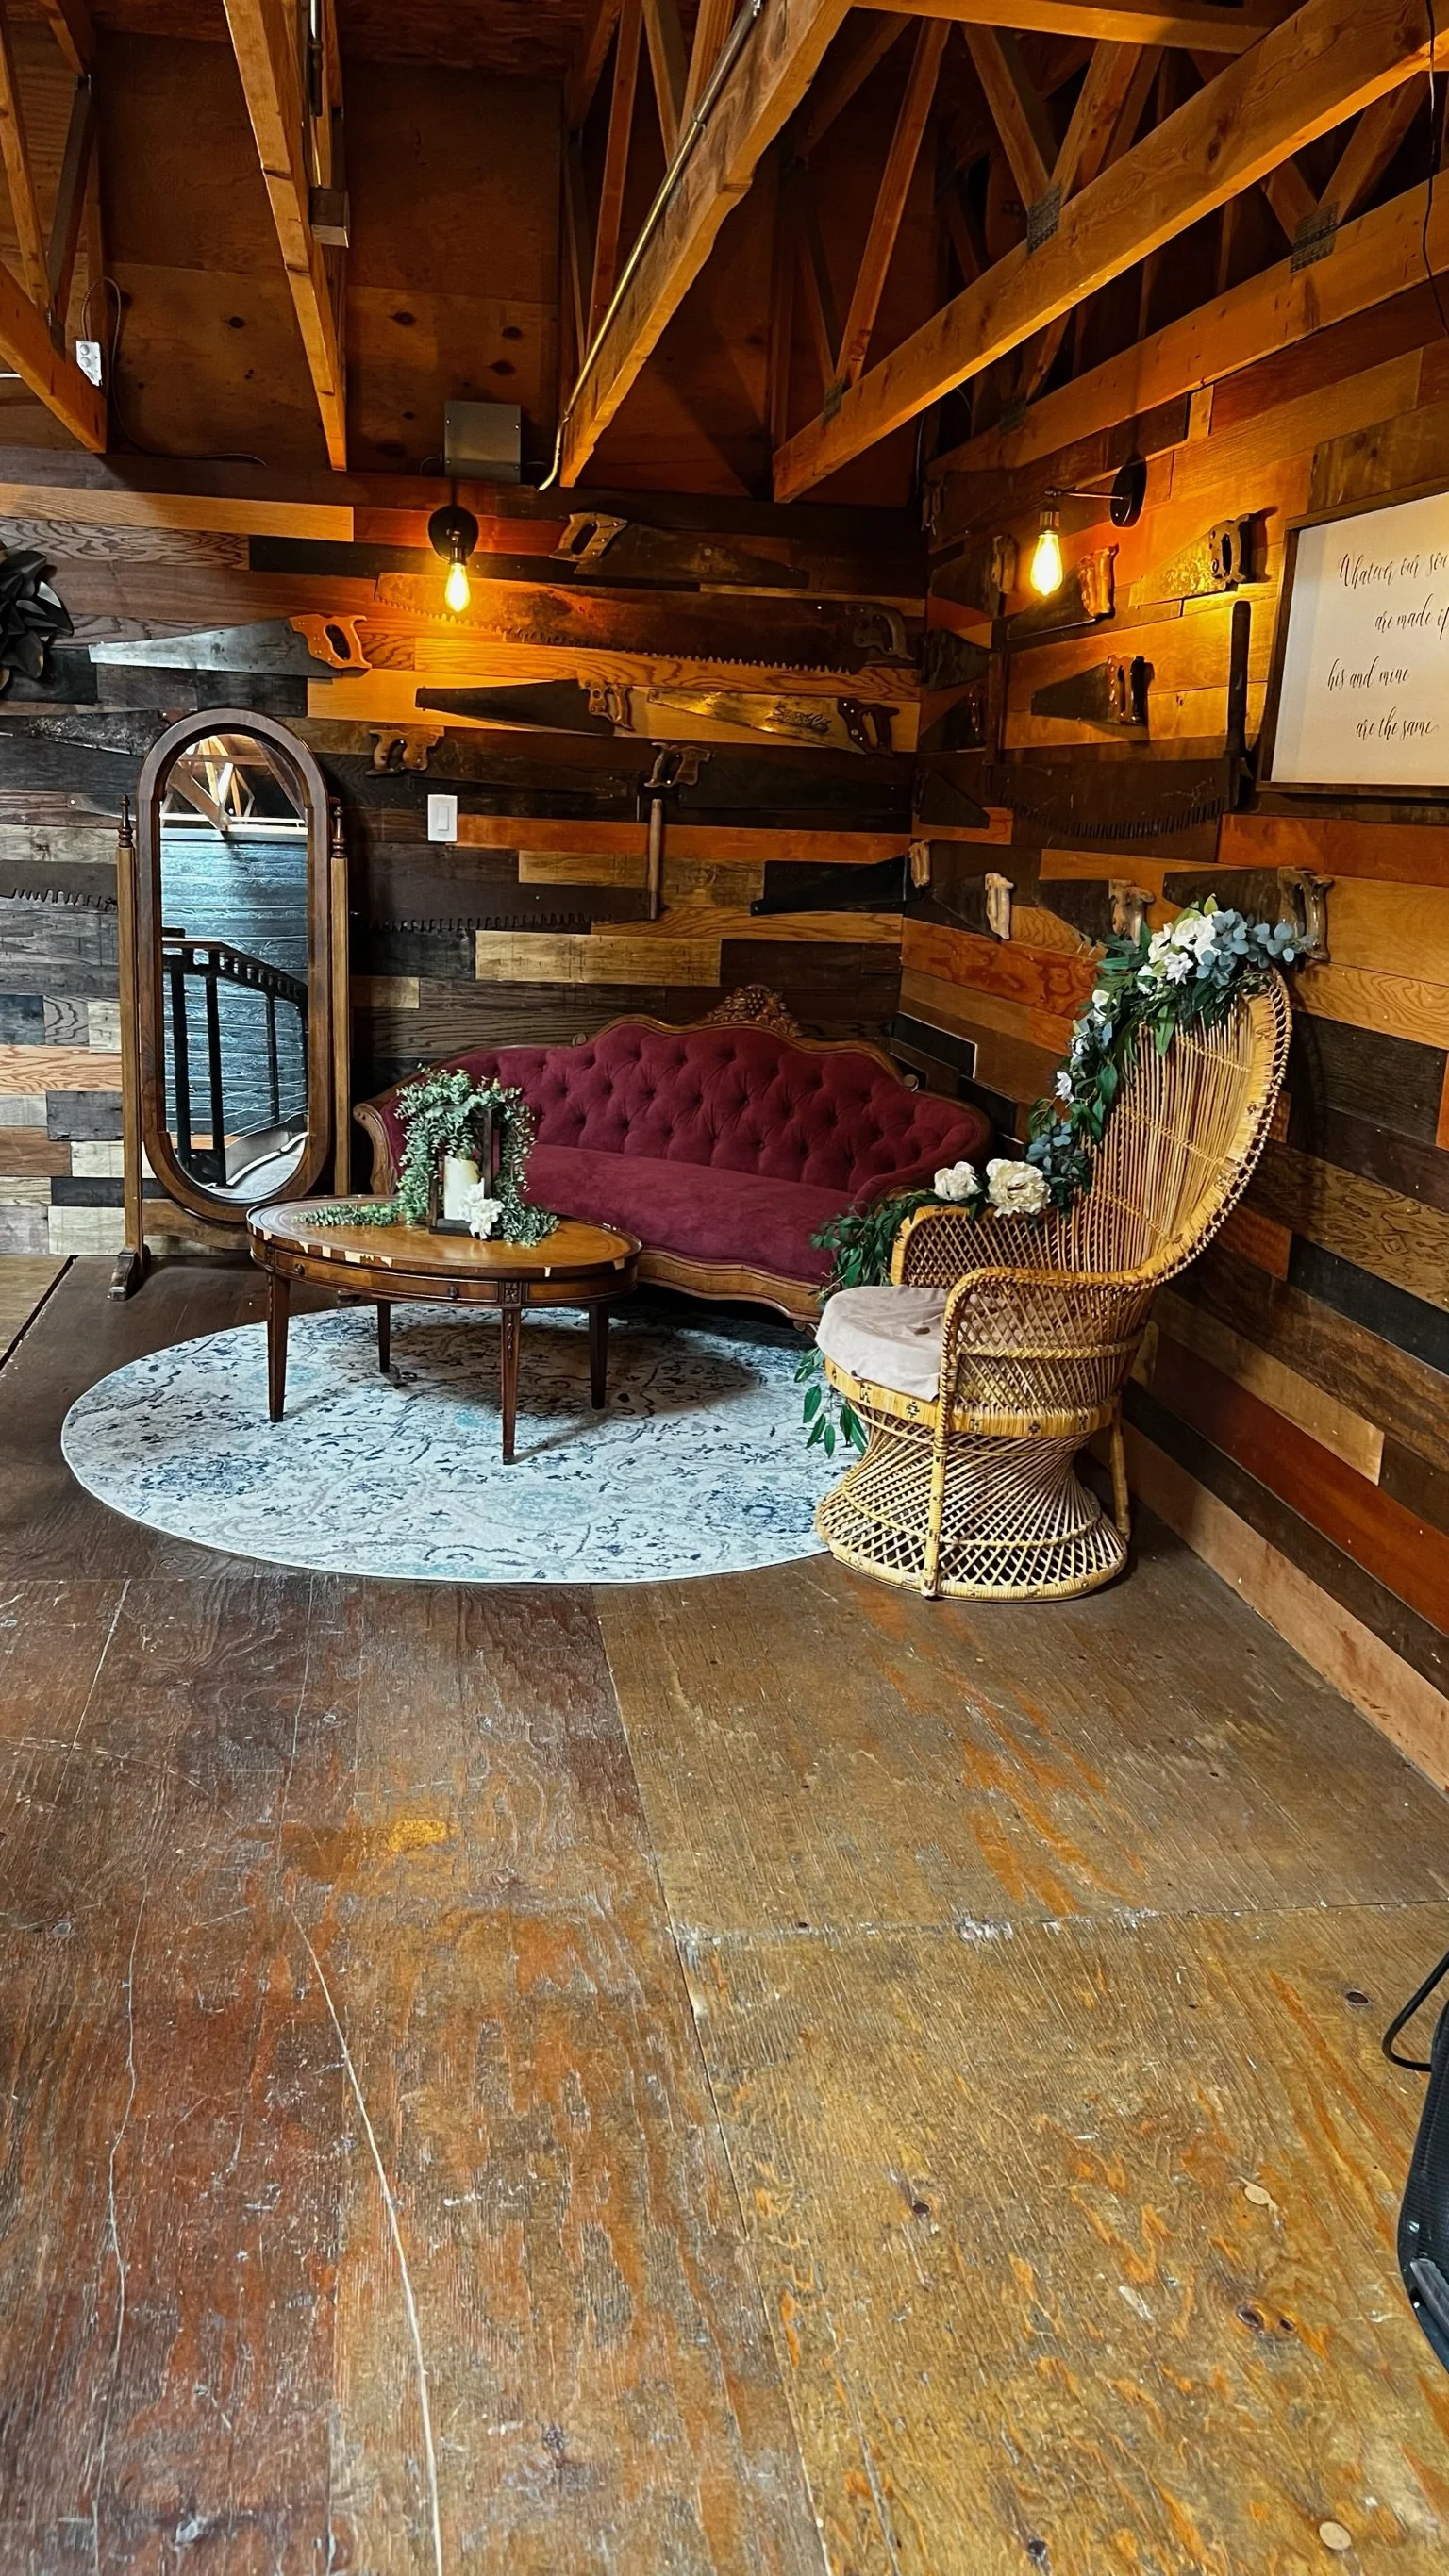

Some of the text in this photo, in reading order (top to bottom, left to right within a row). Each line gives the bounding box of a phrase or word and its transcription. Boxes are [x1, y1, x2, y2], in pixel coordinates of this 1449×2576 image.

[1338, 553, 1393, 590] Whatever
[1400, 554, 1421, 579] our
[1374, 611, 1393, 633] are
[1396, 593, 1433, 630] made
[1327, 656, 1409, 691] his and mine
[1356, 706, 1440, 741] are the same
